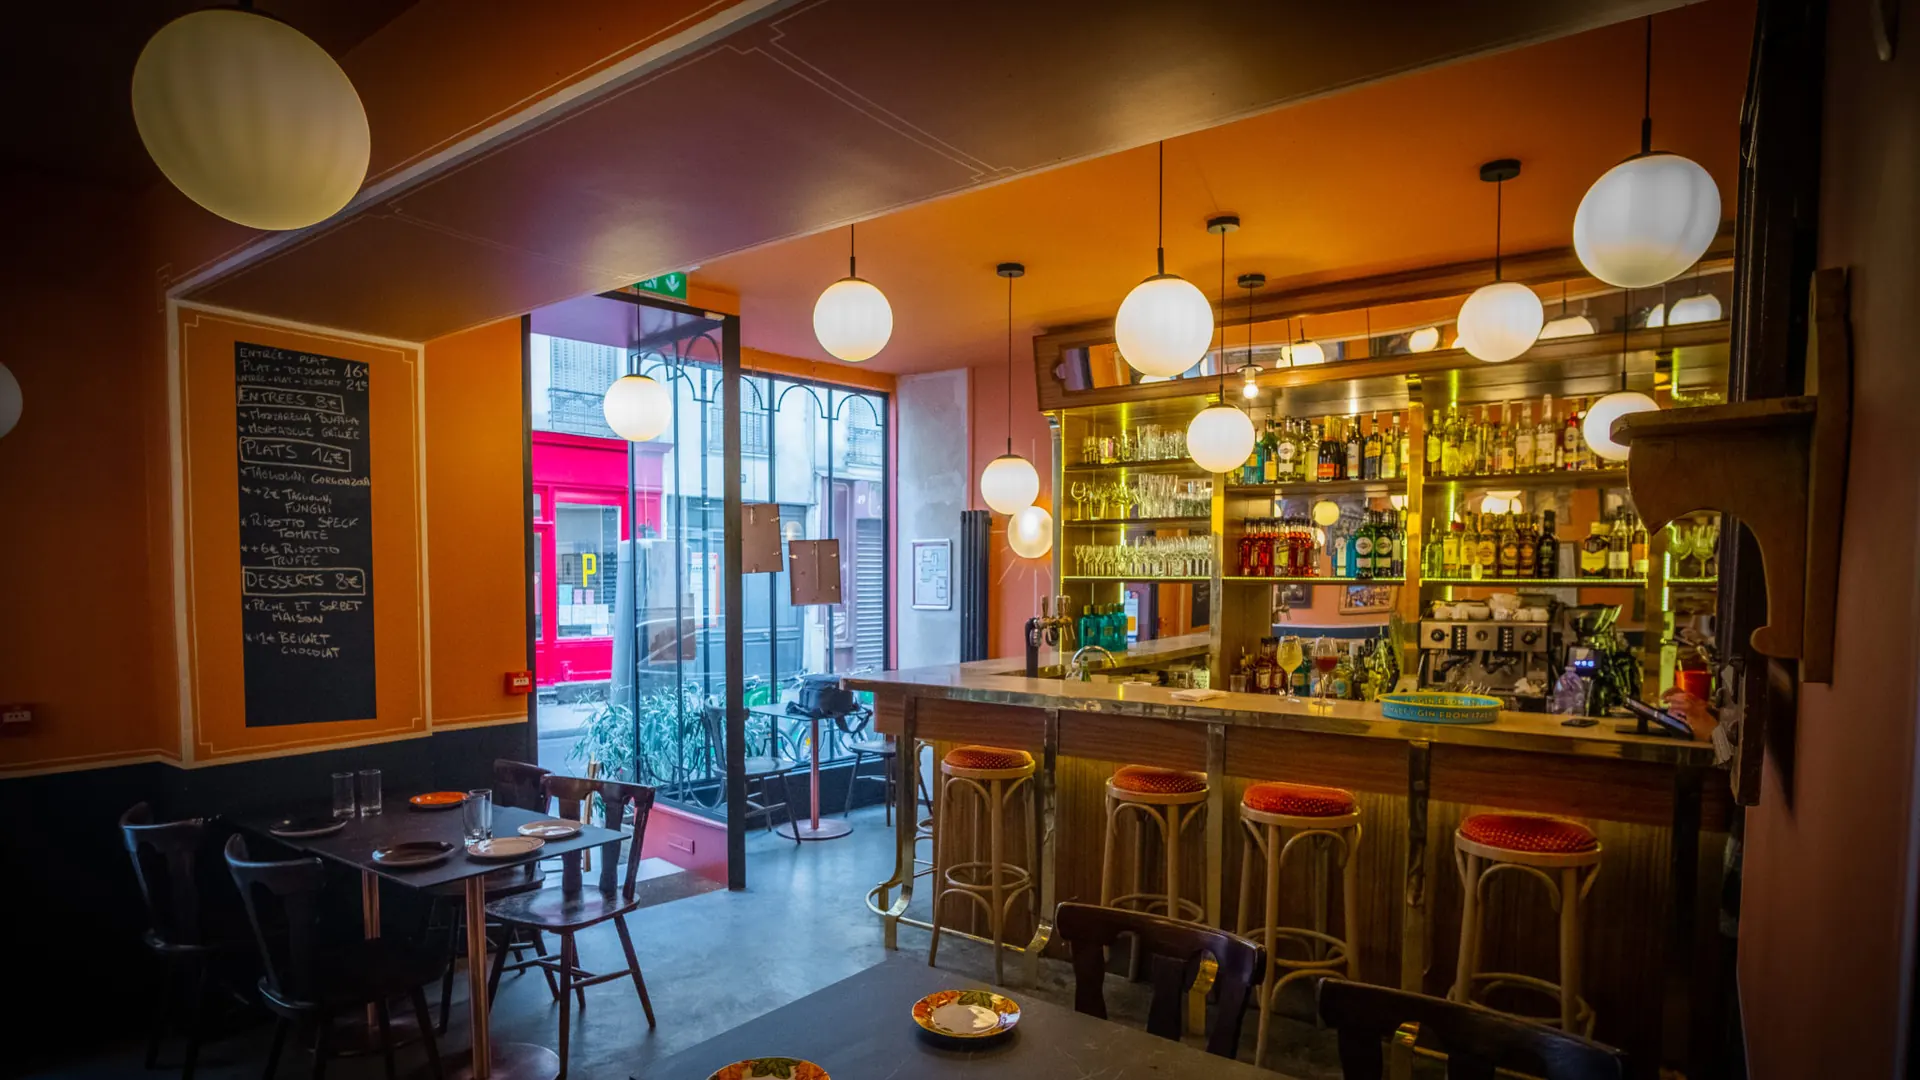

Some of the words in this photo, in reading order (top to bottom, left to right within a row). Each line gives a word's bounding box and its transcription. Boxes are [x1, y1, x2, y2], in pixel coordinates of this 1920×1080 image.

[239, 359, 270, 372] PLAT
[315, 395, 340, 409] 8€
[242, 439, 298, 459] PLATS
[311, 447, 345, 465] 14€
[317, 517, 359, 529] SPECK
[273, 527, 329, 540] TOMATE
[265, 555, 319, 567] TRUFFE
[582, 553, 597, 588] P
[245, 571, 324, 589] DESSERTS
[335, 573, 362, 590] 8€
[294, 601, 311, 612] ET
[319, 601, 363, 612] SORBET
[272, 612, 323, 623] MAISON
[278, 631, 331, 645] BEIGNET
[281, 647, 340, 658] CHOCOLAT
[1439, 711, 1469, 720] FROM
